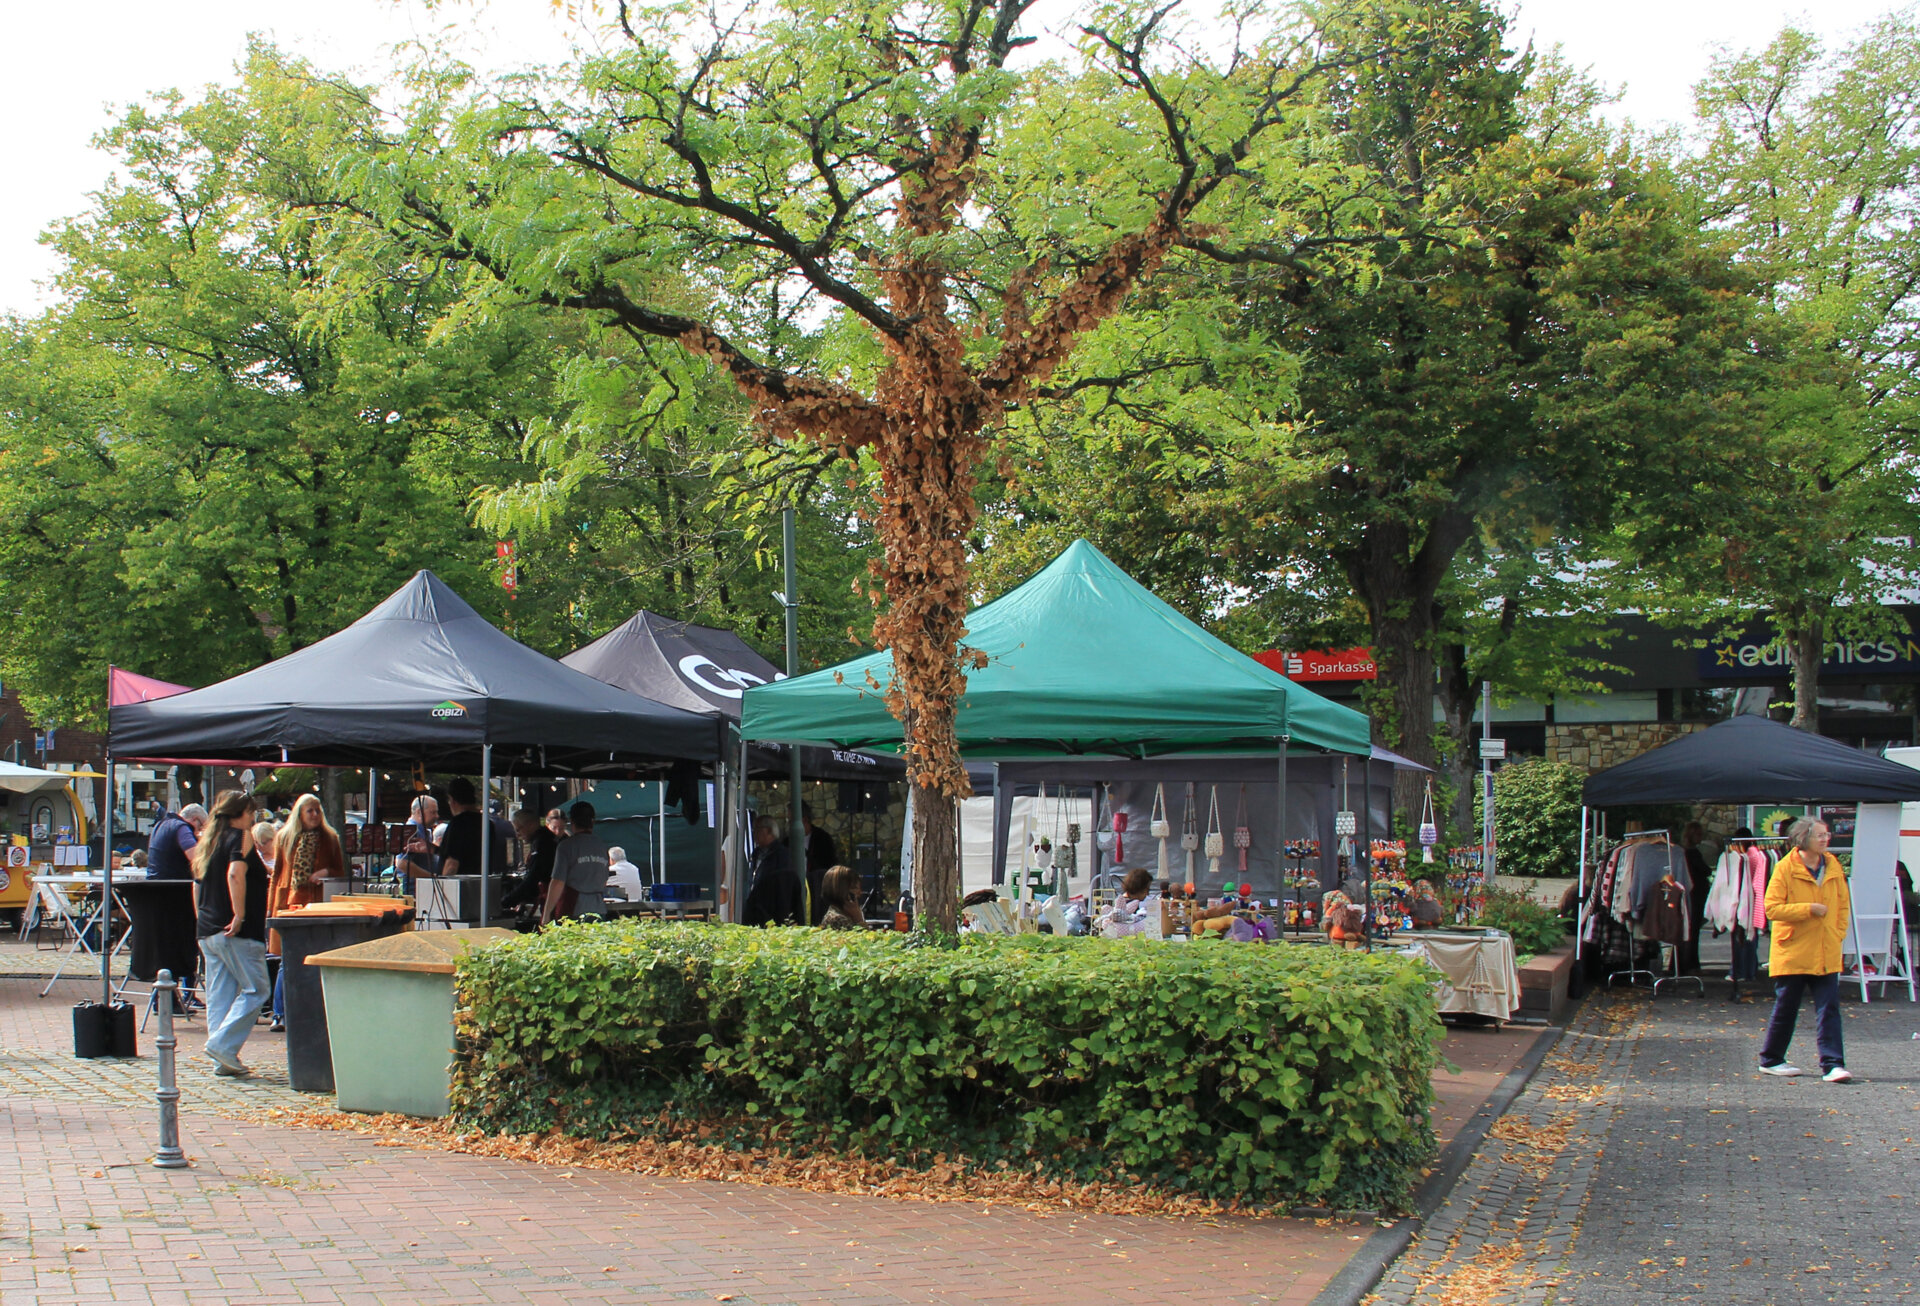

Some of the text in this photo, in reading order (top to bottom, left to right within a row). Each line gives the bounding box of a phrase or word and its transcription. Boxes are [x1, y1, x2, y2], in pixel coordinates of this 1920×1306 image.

[1309, 662, 1373, 675] Sparkasse
[431, 708, 464, 717] COBIZI
[832, 750, 843, 761] THE
